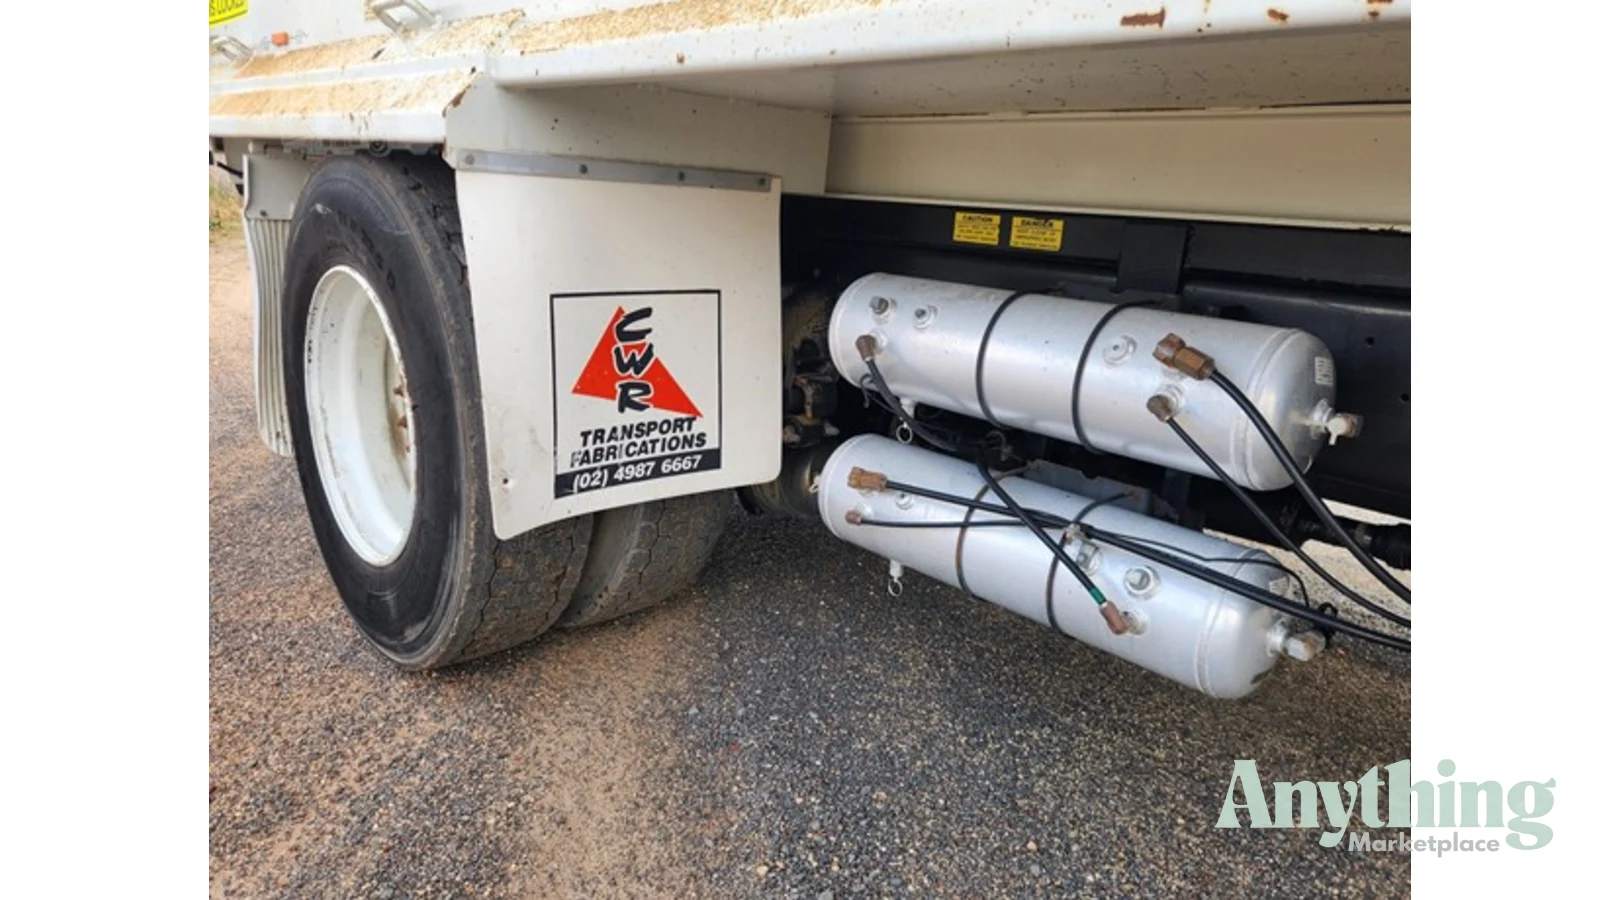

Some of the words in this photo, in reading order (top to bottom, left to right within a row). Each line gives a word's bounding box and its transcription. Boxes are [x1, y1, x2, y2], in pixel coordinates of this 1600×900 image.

[613, 307, 654, 414] CWR
[570, 432, 707, 468] FABRICATIONS
[580, 416, 697, 448] TRANSPORT
[573, 469, 609, 493] (02)
[613, 461, 656, 481] 4987
[661, 454, 702, 474] 6667
